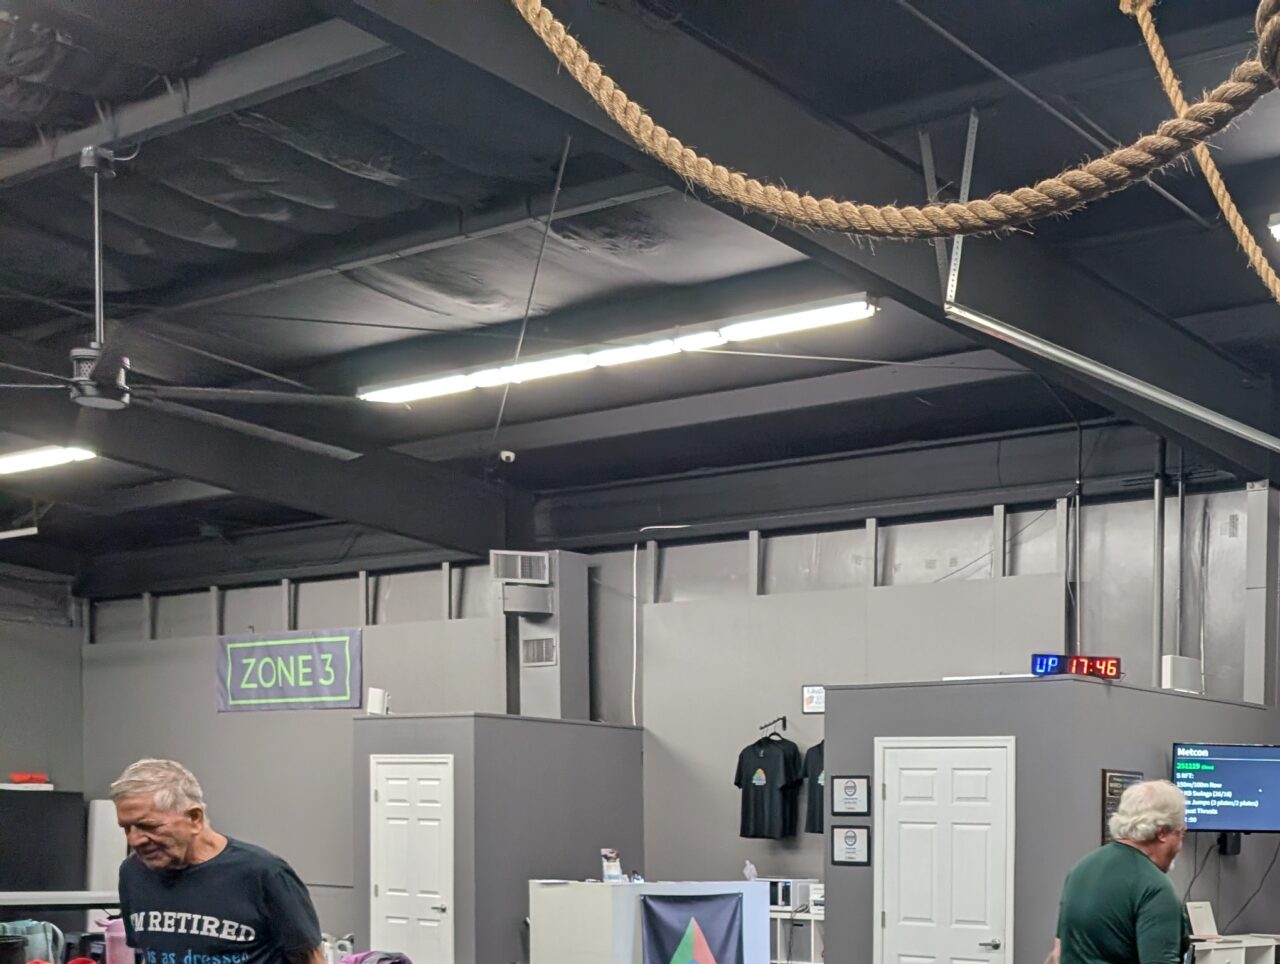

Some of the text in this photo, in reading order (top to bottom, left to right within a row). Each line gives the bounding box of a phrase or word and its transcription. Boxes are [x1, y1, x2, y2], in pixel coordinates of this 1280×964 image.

[240, 653, 335, 688] ZONE 3
[1035, 656, 1118, 677] UP 17:46
[1177, 747, 1209, 757] Metcon
[148, 911, 256, 942] RETIRED
